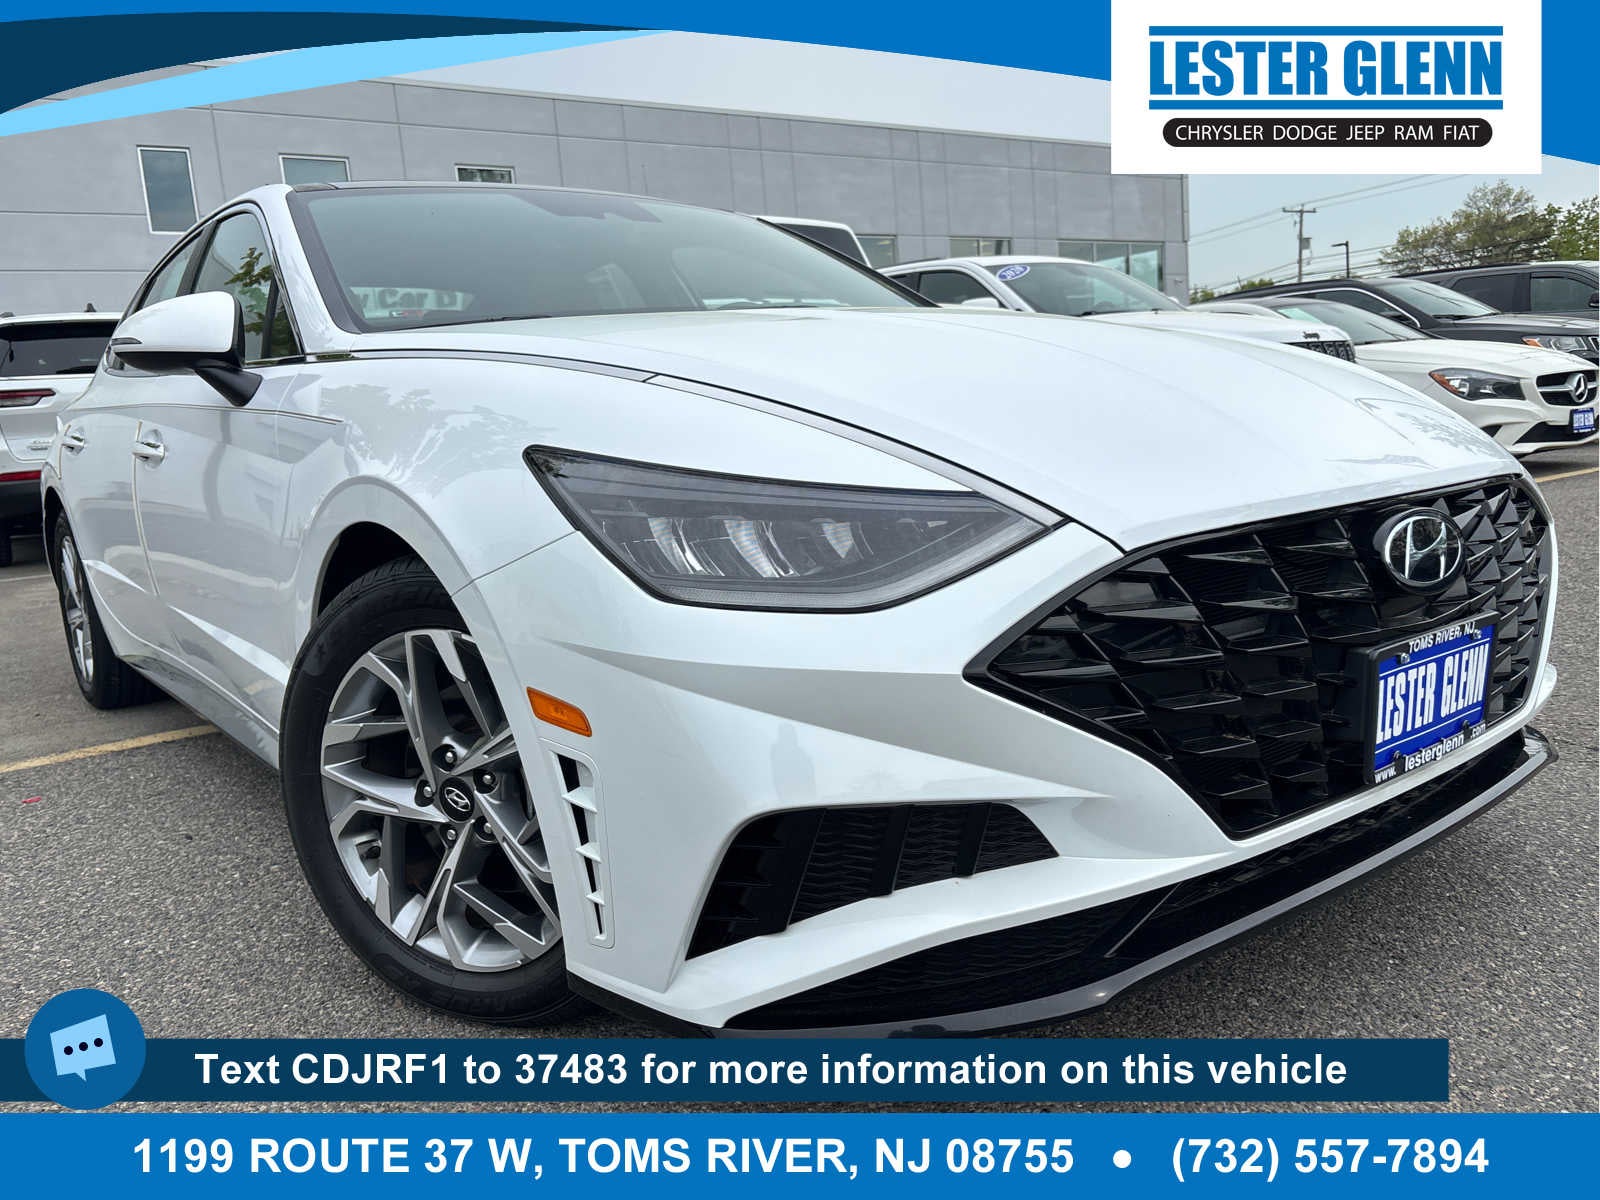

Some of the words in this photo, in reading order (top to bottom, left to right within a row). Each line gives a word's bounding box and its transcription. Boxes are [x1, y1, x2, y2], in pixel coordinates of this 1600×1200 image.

[1409, 635, 1434, 654] TOMS
[1436, 626, 1462, 645] RIVER,
[1376, 661, 1437, 745] LESTER
[1440, 643, 1490, 718] GLENN
[1374, 764, 1397, 784] www.
[1403, 733, 1464, 772] lesterglenn
